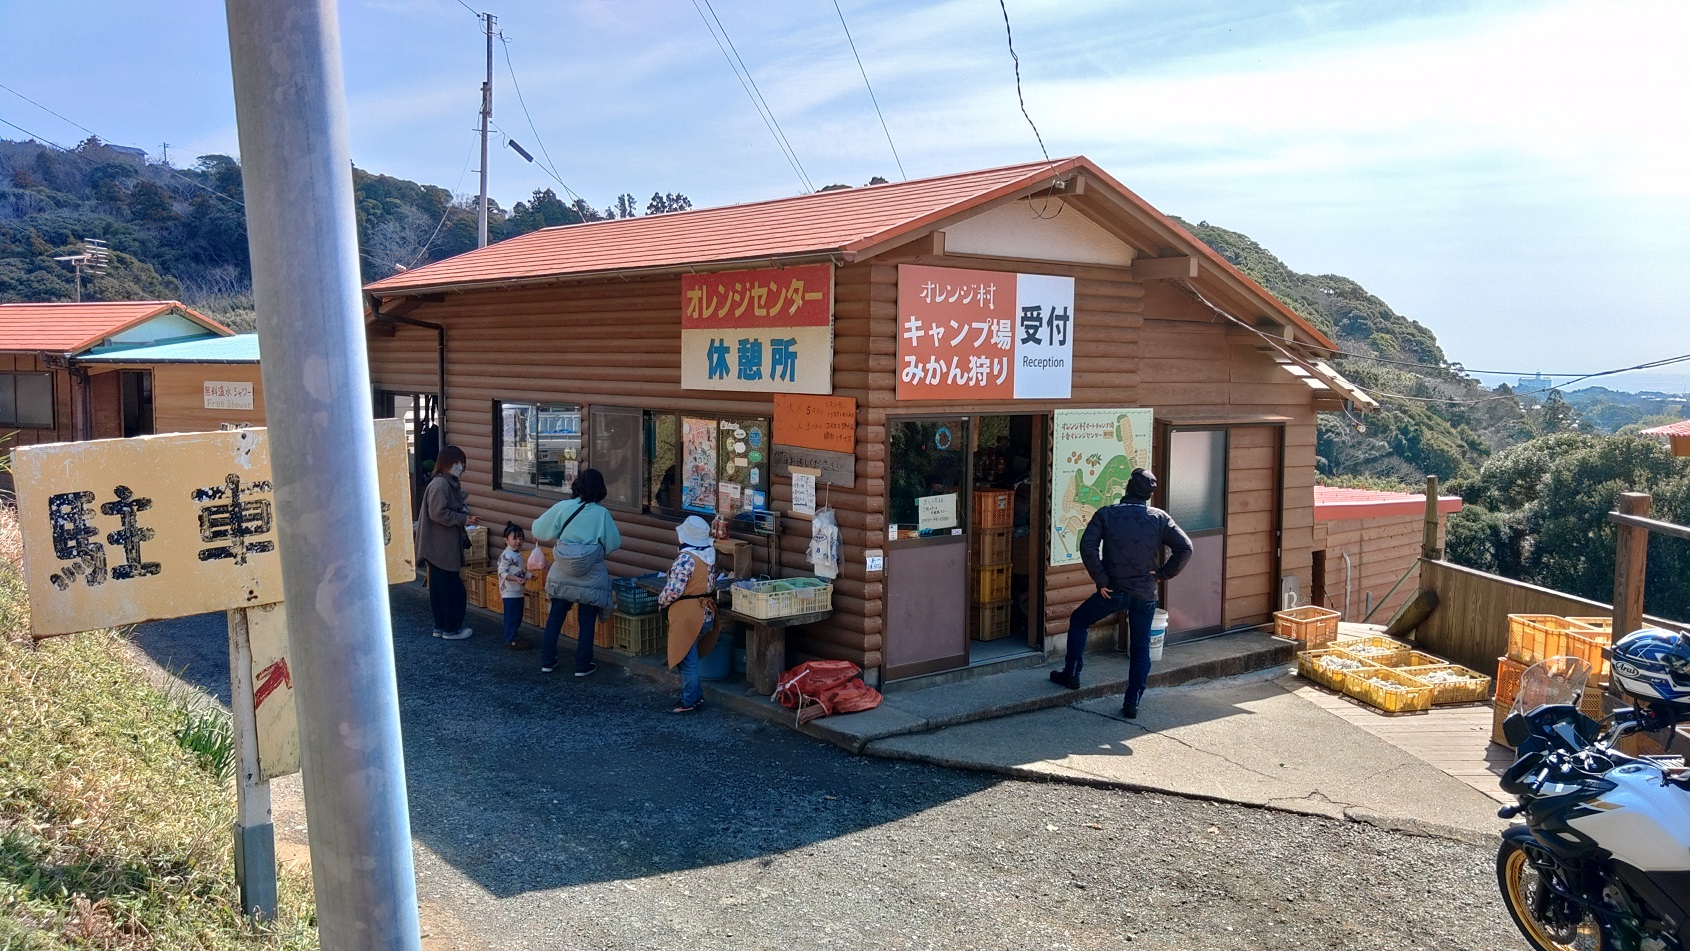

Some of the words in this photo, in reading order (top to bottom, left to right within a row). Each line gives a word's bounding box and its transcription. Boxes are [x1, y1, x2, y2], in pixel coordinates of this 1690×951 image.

[686, 278, 824, 318] オレンジセンター
[920, 281, 997, 310] オレンジ村
[903, 315, 1013, 351] キャンプ場
[1020, 305, 1070, 347] 受付
[706, 337, 798, 383] 休憩所
[901, 354, 1009, 387] みかん狩り
[1022, 355, 1065, 370] Reception
[207, 398, 225, 408] Free
[226, 399, 252, 409] Shower
[1617, 662, 1637, 675] Arai
